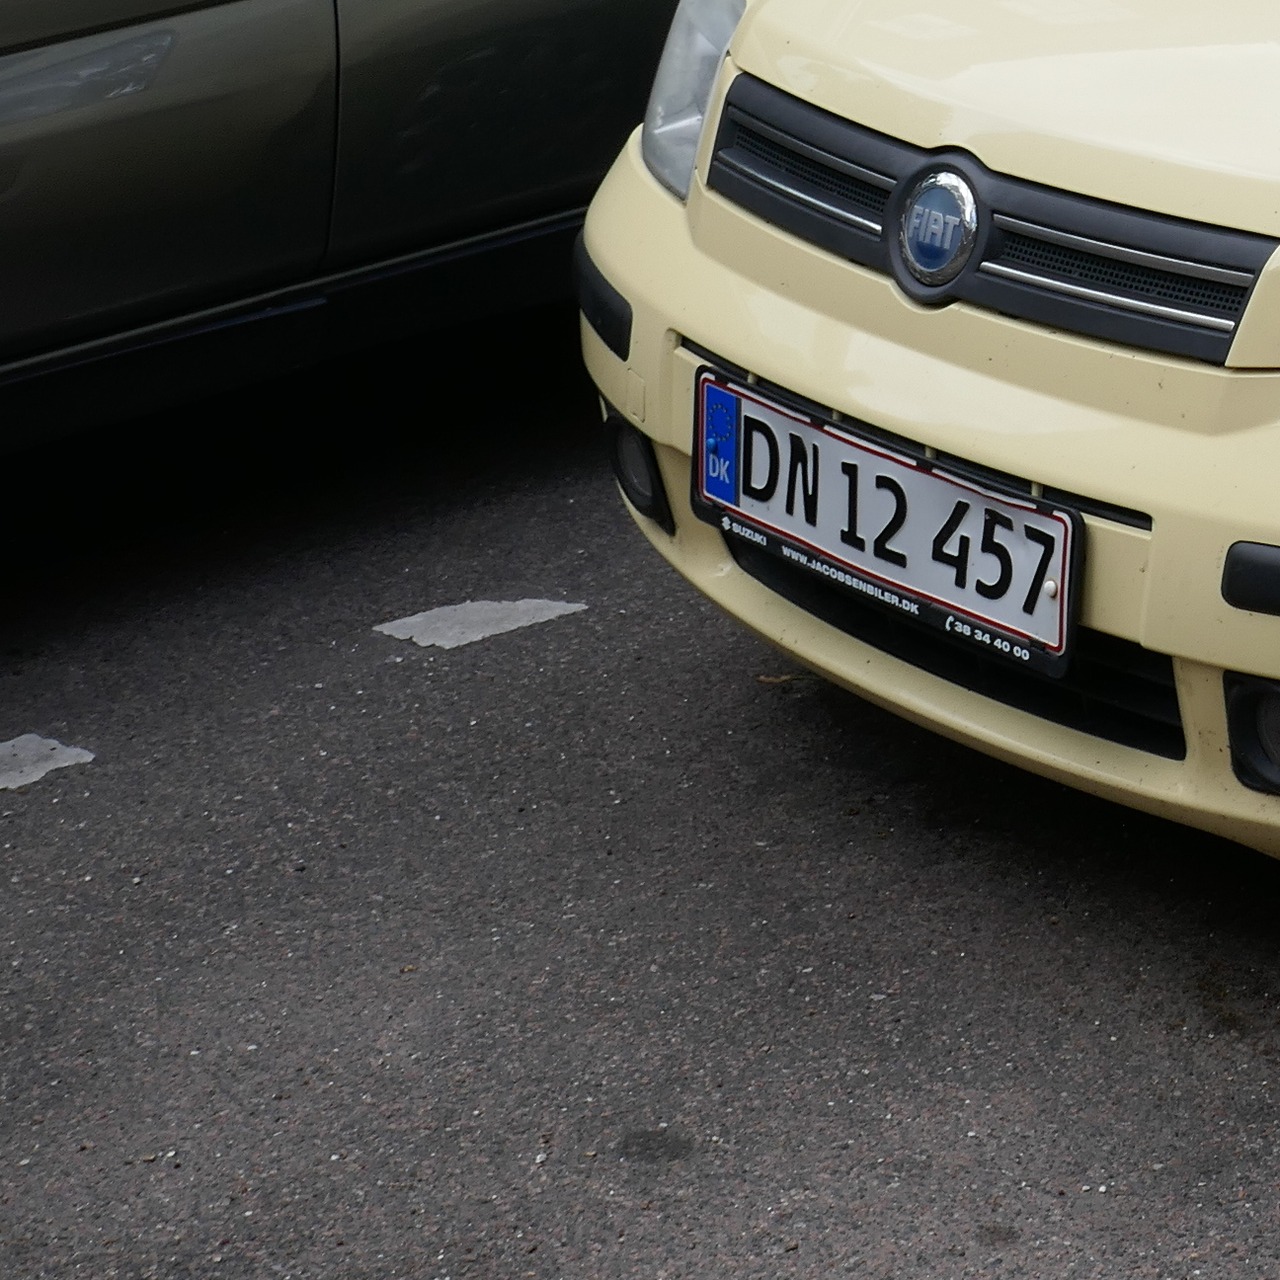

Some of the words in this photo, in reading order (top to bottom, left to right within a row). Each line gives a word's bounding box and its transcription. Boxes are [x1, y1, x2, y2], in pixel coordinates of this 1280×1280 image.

[907, 205, 961, 250] FIAT
[707, 453, 730, 484] DK
[742, 414, 820, 528] DN
[840, 461, 908, 569] 12
[931, 500, 1056, 616] 457
[731, 521, 768, 547] SUZUKI
[781, 545, 920, 615] WWW.JACOBSENBILER.DK
[954, 621, 972, 636] 38
[974, 629, 992, 644] 34
[993, 638, 1011, 653] 40
[1012, 645, 1030, 661] 00
